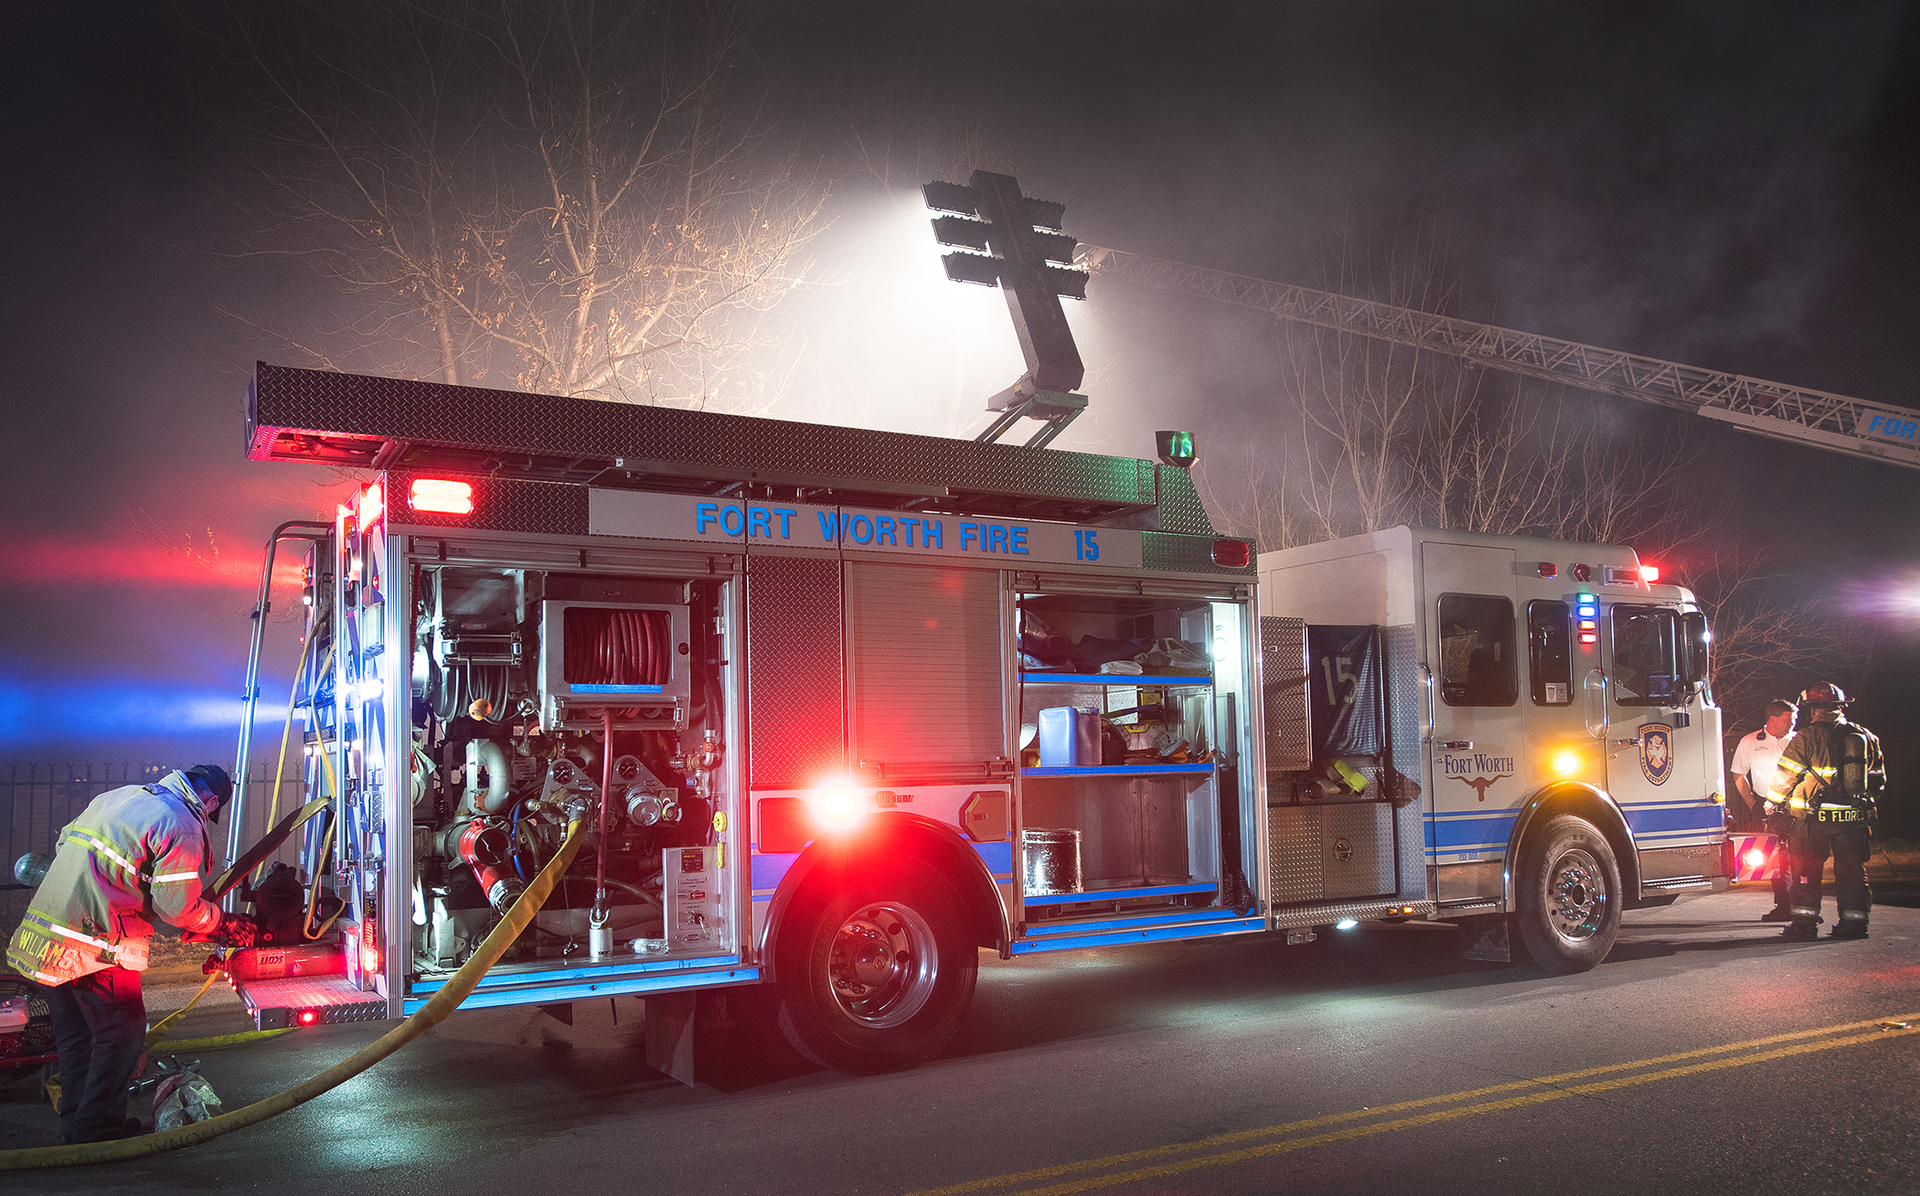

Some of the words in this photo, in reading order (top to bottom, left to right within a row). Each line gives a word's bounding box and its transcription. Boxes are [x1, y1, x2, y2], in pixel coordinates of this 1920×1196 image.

[1869, 415, 1920, 442] FOR
[696, 503, 797, 539] FORT
[817, 510, 943, 549] WORTH
[960, 522, 1029, 555] FIRE
[1073, 530, 1099, 561] 15
[1321, 655, 1358, 706] 15
[1445, 755, 1472, 773] FORT
[1474, 754, 1514, 772] WORTH
[1818, 811, 1826, 822] G
[1832, 811, 1865, 822] FLOR
[260, 955, 284, 964] SCOTT
